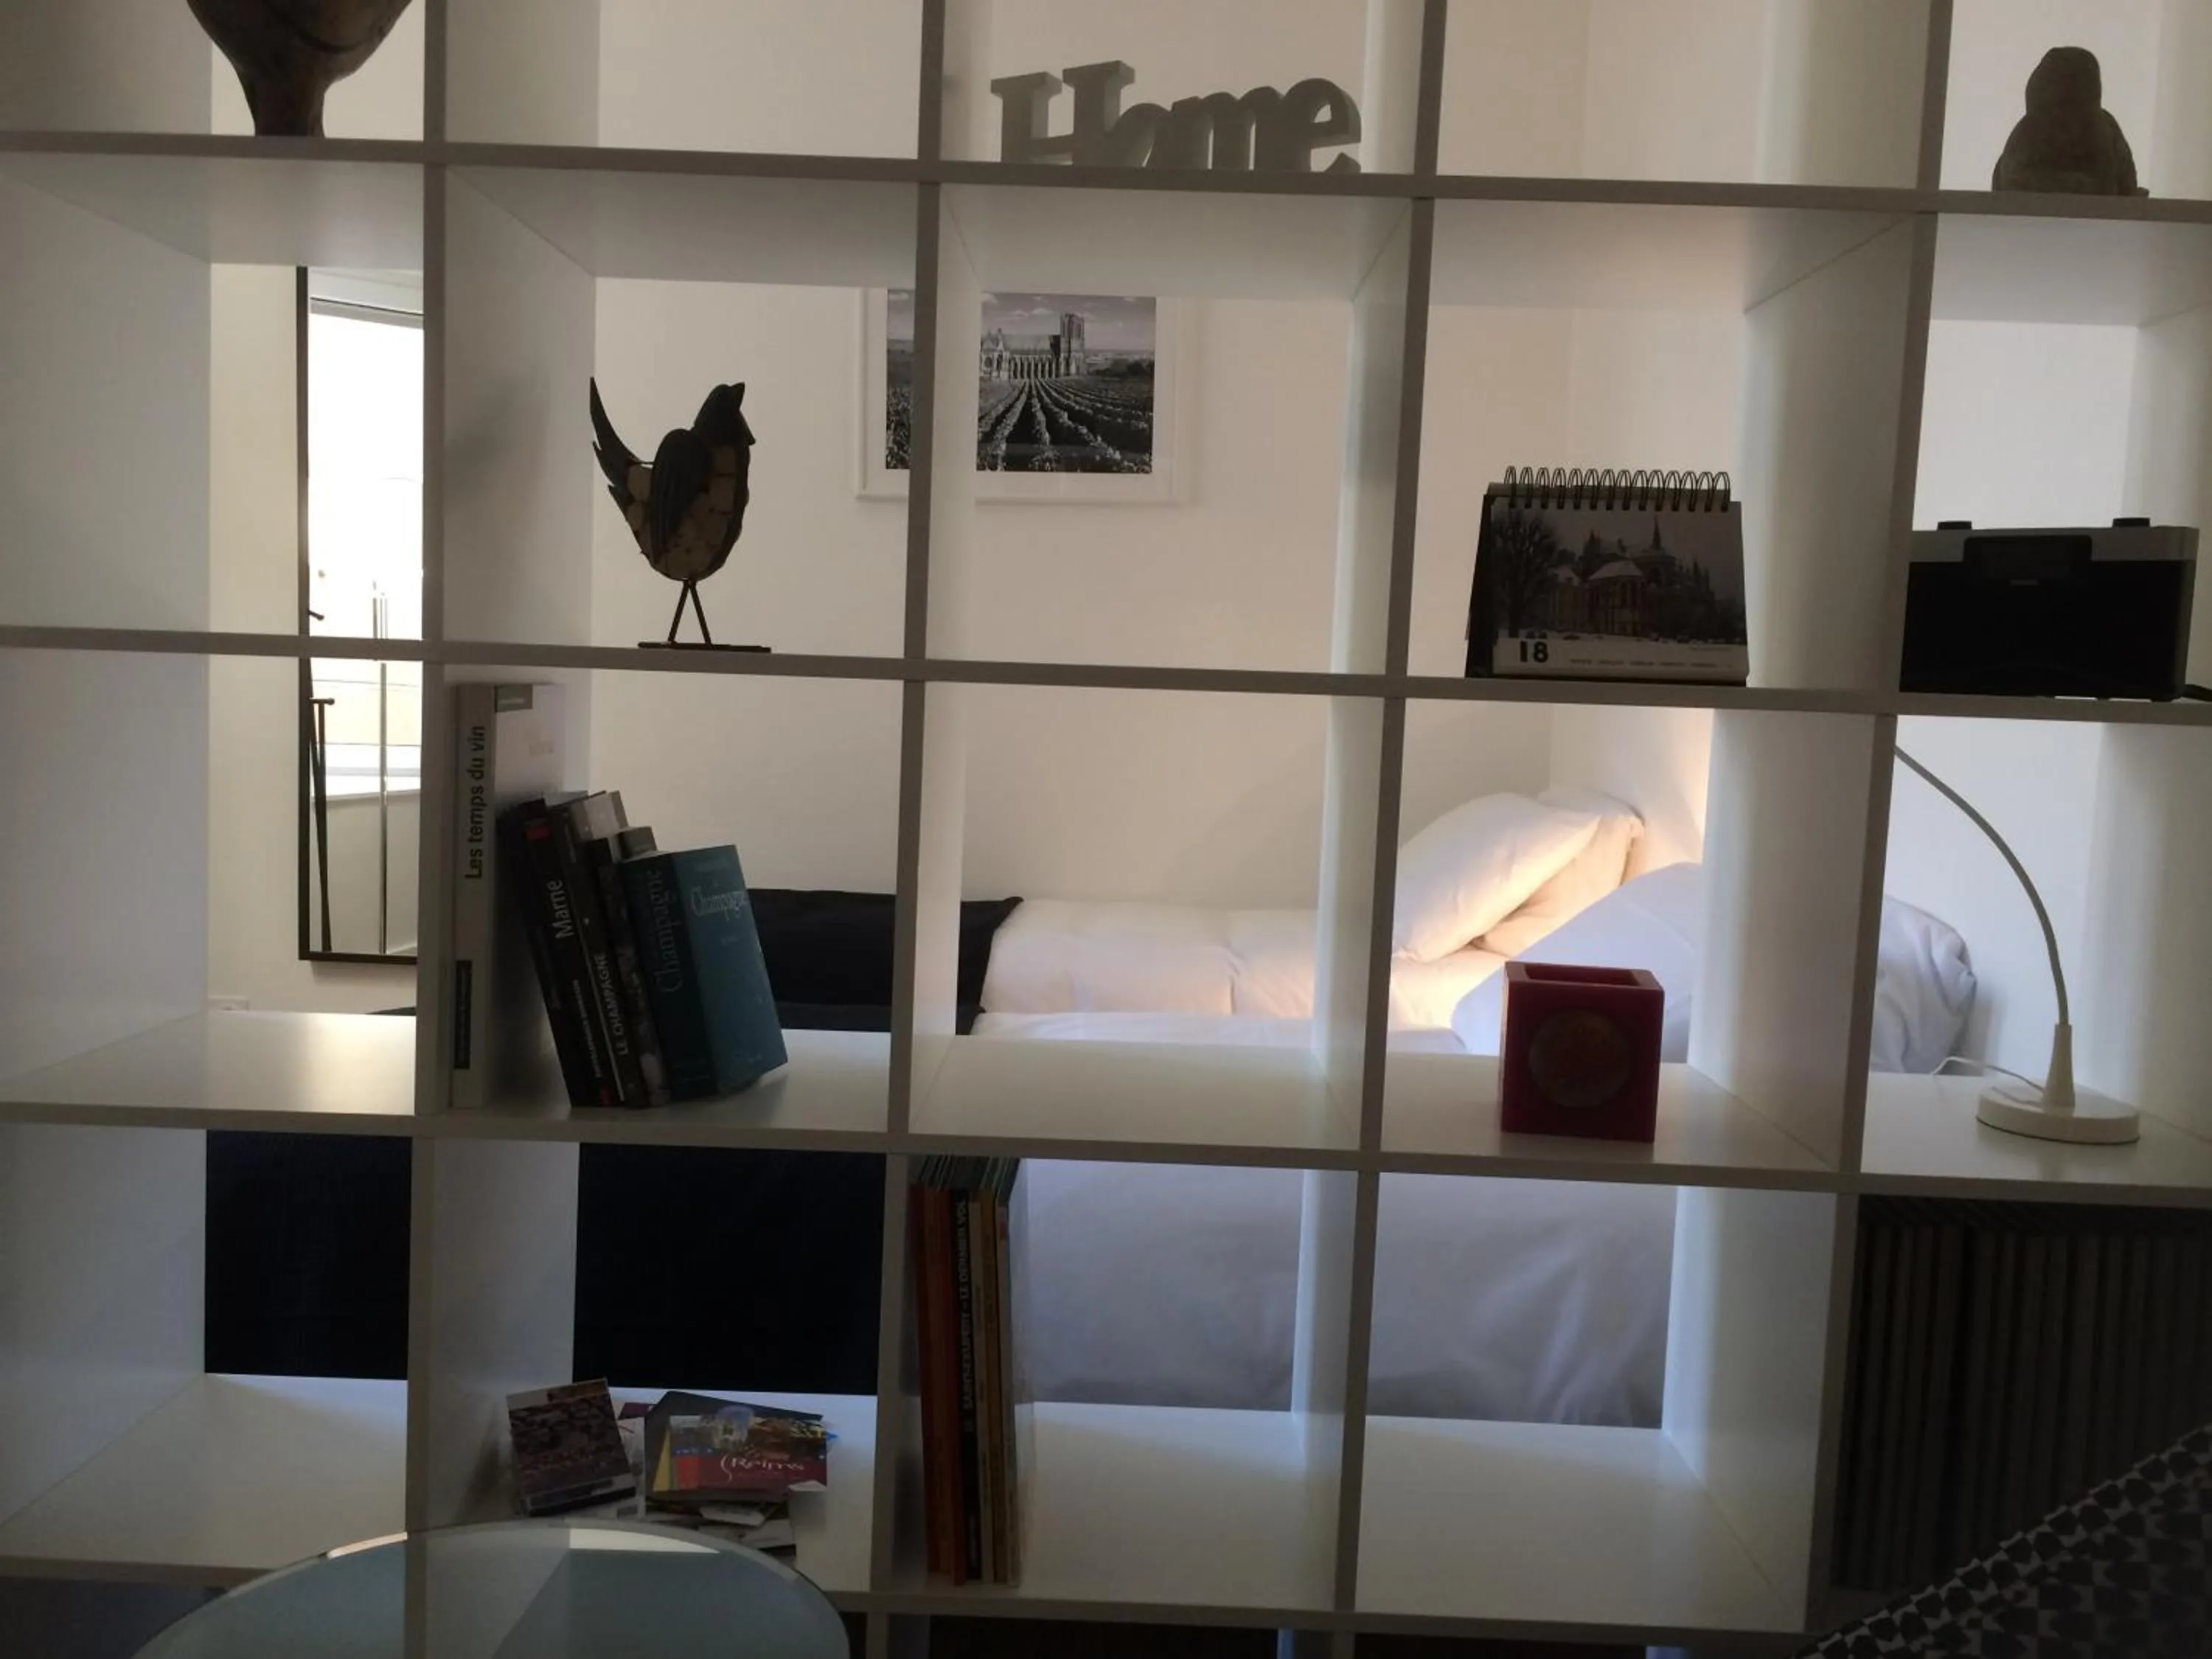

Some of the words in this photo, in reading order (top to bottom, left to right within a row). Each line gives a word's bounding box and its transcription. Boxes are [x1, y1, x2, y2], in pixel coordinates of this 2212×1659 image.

[990, 60, 1362, 175] Home
[1520, 641, 1548, 662] 18
[467, 726, 485, 752] vin
[467, 758, 485, 780] du
[467, 785, 487, 843] temps
[465, 849, 483, 879] Les
[546, 879, 575, 939] Marne
[594, 950, 625, 1036] CHAMPAGNE
[616, 1037, 628, 1057] LE
